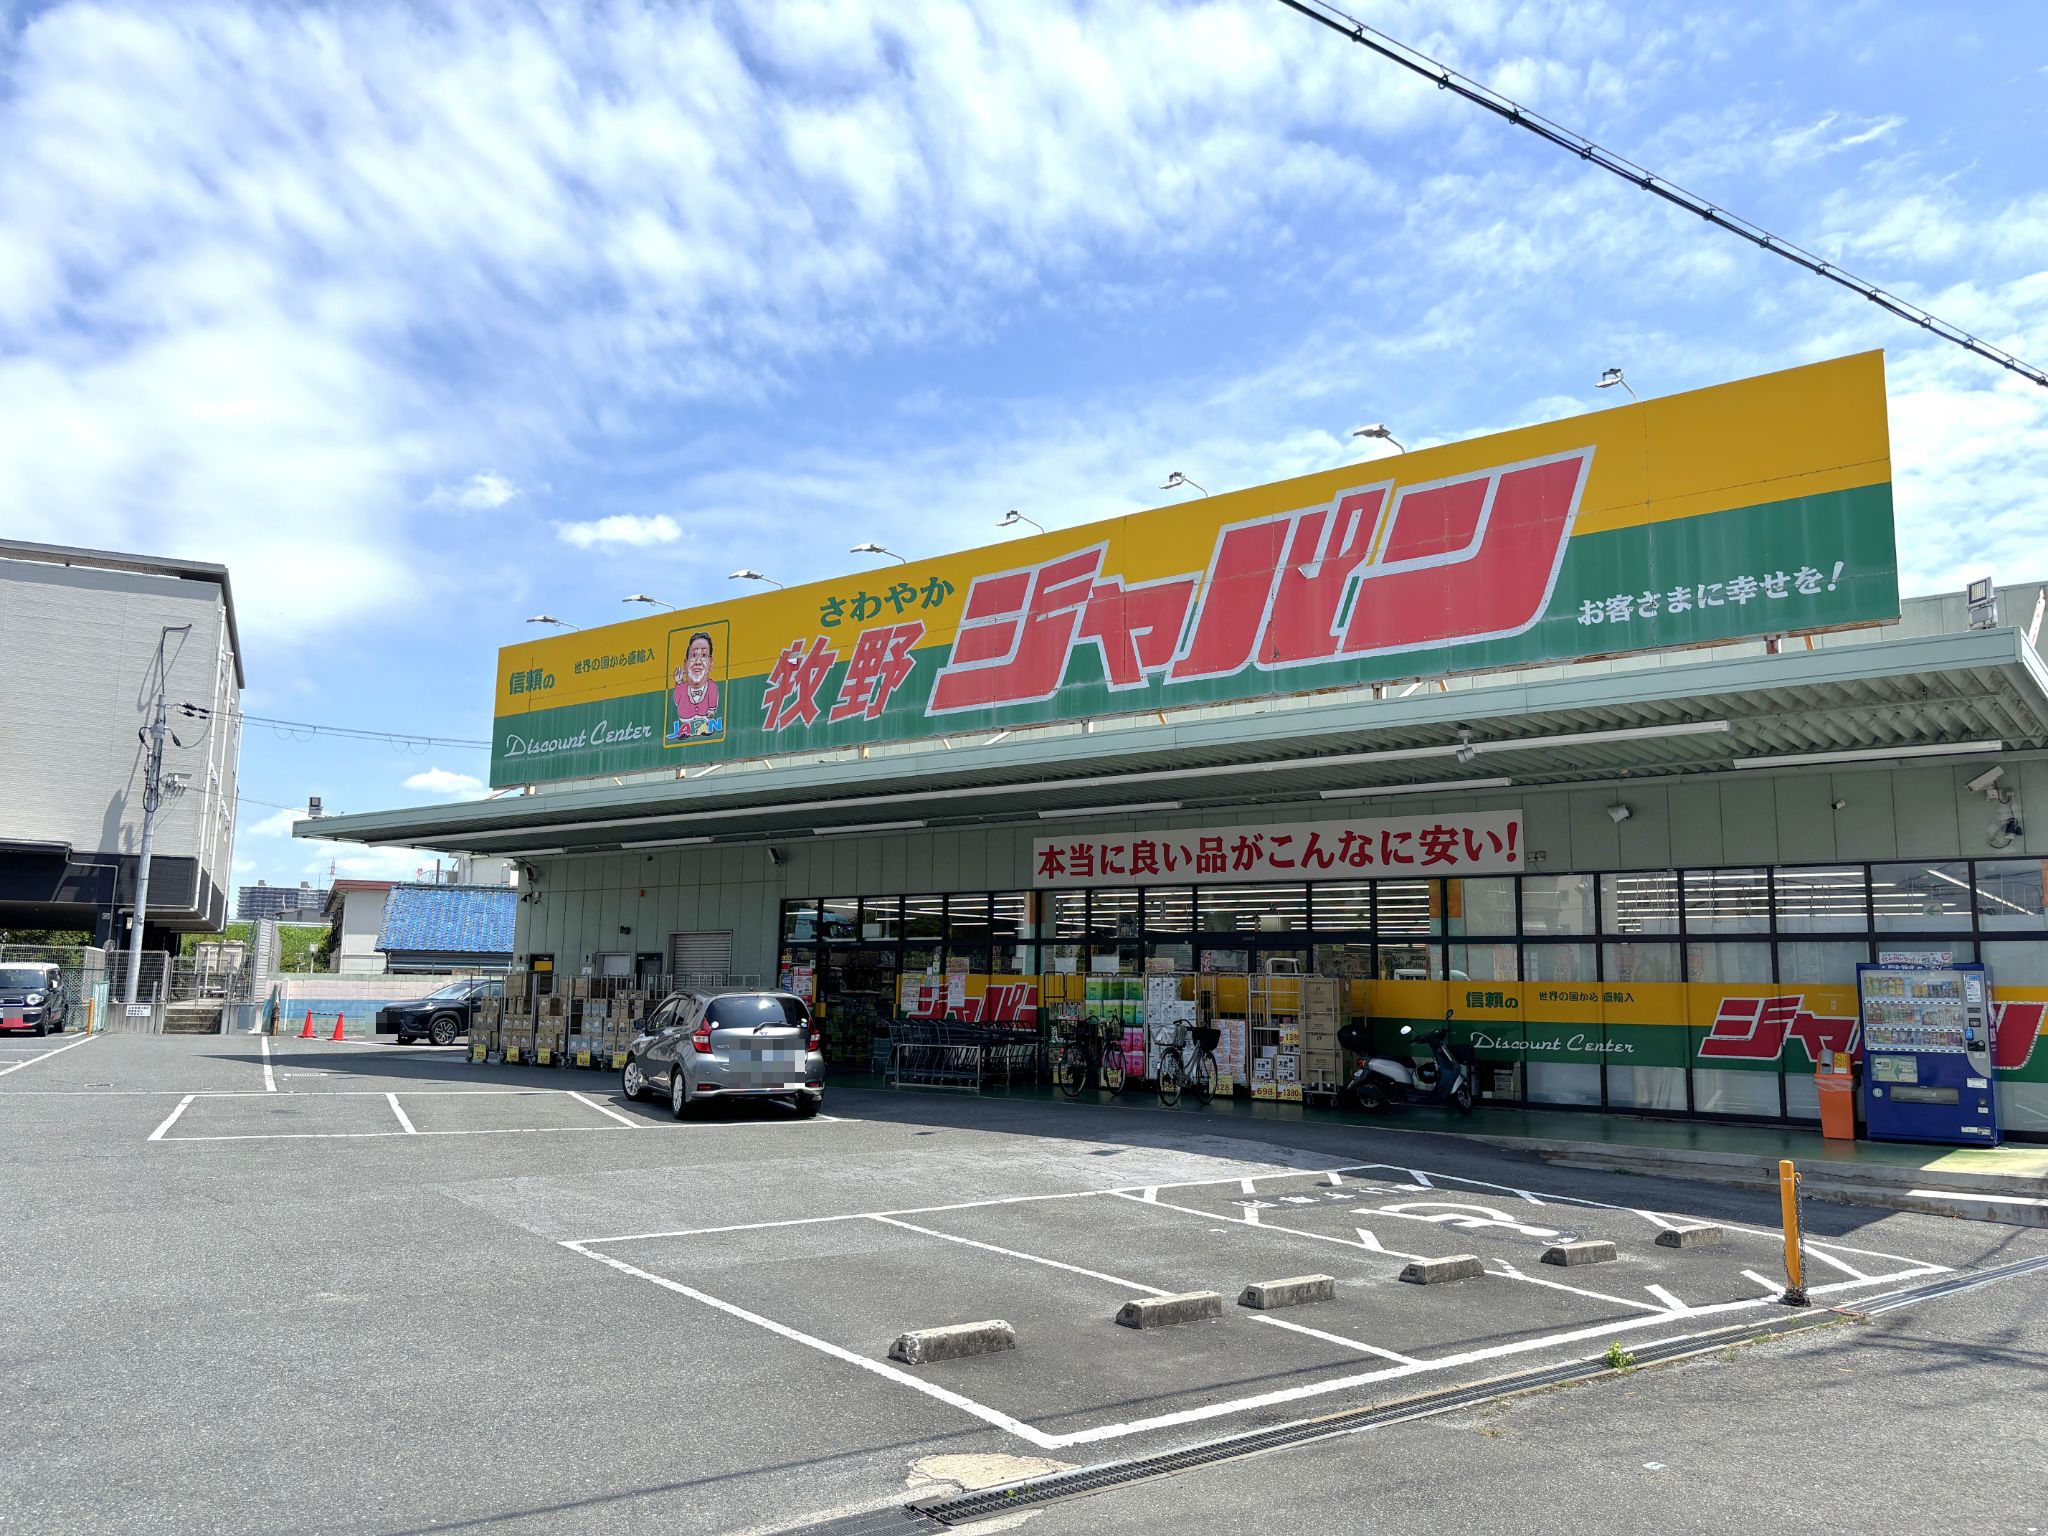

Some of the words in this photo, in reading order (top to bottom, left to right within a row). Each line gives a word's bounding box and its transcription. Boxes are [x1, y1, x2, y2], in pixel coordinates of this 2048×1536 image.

[924, 444, 1597, 718] ジャパン
[1577, 561, 1844, 625] お客さまに幸せを!
[820, 577, 955, 627] さわやか
[574, 648, 655, 674] 世界の国から直輸入
[761, 619, 926, 733] 牧野
[509, 668, 556, 695] 信頼の
[504, 729, 586, 757] Discount
[590, 720, 652, 745] Center
[666, 717, 723, 739] JAPAN
[1037, 821, 1518, 880] 本当に良い品がこんなに安い!
[1466, 991, 1519, 1008] 信頼の
[1539, 991, 1634, 1003] 世界の国から直輸入
[1470, 1031, 1561, 1051] Discount
[1566, 1033, 1635, 1053] Center
